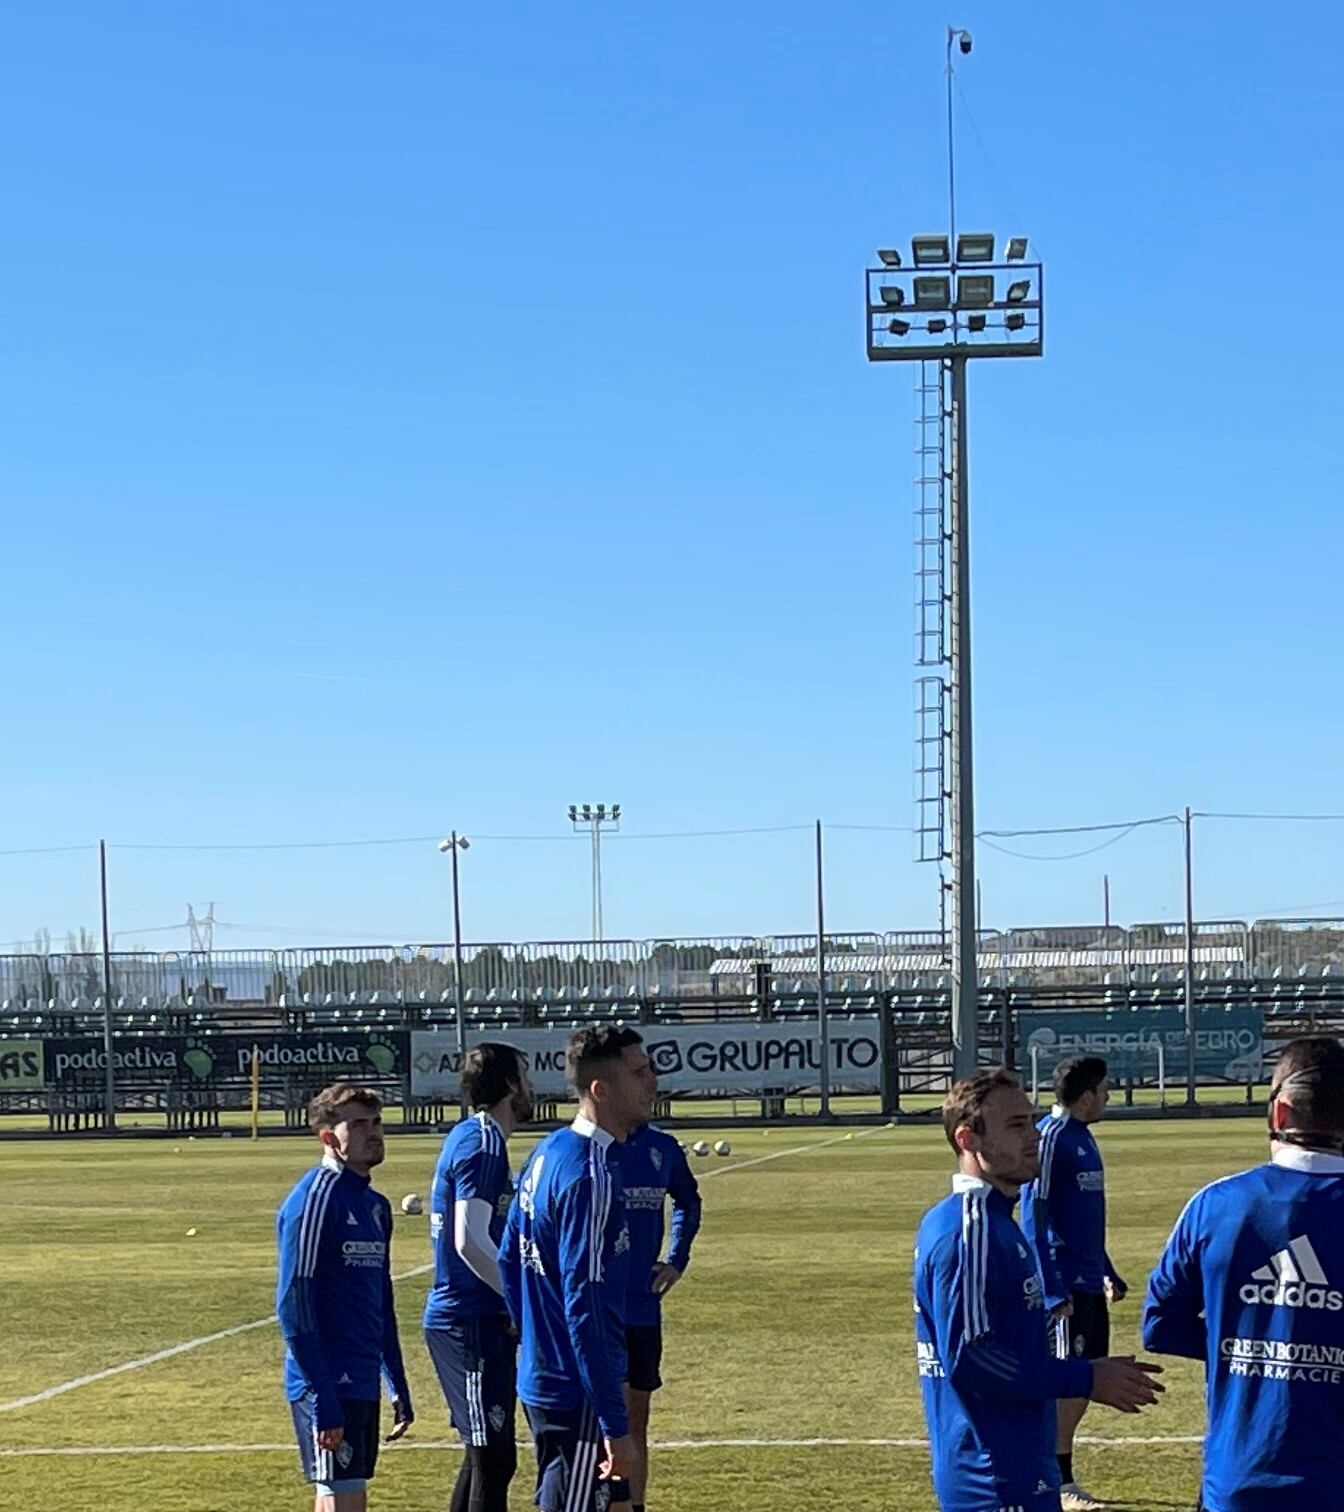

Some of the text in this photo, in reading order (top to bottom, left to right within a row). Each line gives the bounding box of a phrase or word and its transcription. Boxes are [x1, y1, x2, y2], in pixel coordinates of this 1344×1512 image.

[1194, 1028, 1254, 1050] EBRO
[55, 1047, 177, 1078] podoactiva
[238, 1042, 360, 1072] podoactiva
[686, 1037, 879, 1072] GRUPAUTO
[1239, 1279, 1344, 1311] adidas
[1229, 1361, 1342, 1384] PHARMACIE
